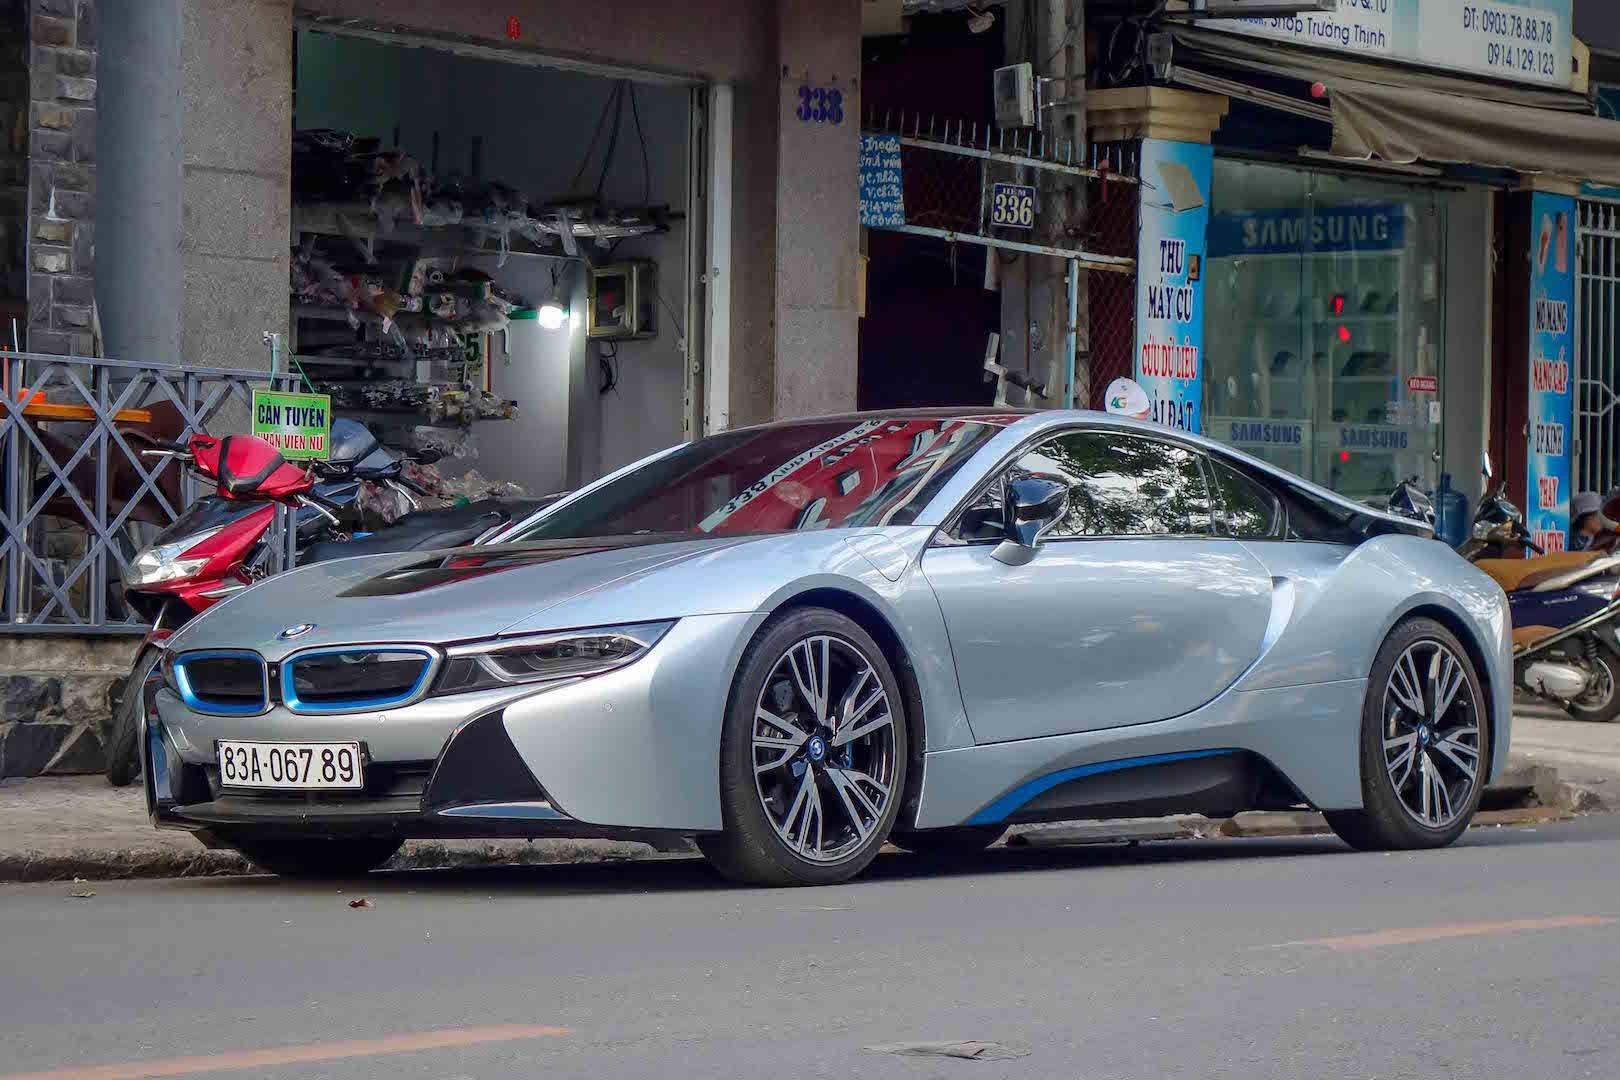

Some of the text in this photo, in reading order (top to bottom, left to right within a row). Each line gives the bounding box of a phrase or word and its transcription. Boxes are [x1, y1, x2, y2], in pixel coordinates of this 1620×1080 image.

[1307, 16, 1349, 45] Trường
[1354, 25, 1385, 48] Thịnh
[1464, 7, 1552, 44] ĐT: 0903.78.88.78
[1487, 42, 1554, 75] 0914.129.123
[797, 86, 843, 124] 338
[994, 194, 1032, 225] 336
[1242, 205, 1388, 247] SAMSUNG
[1160, 240, 1184, 274] THU
[1148, 276, 1173, 320] MÁY
[1149, 388, 1164, 424] ÀI
[1231, 422, 1301, 444] SAMSUNG
[1340, 427, 1408, 449] SAMSUNG
[225, 746, 354, 783] 83A-067.89
